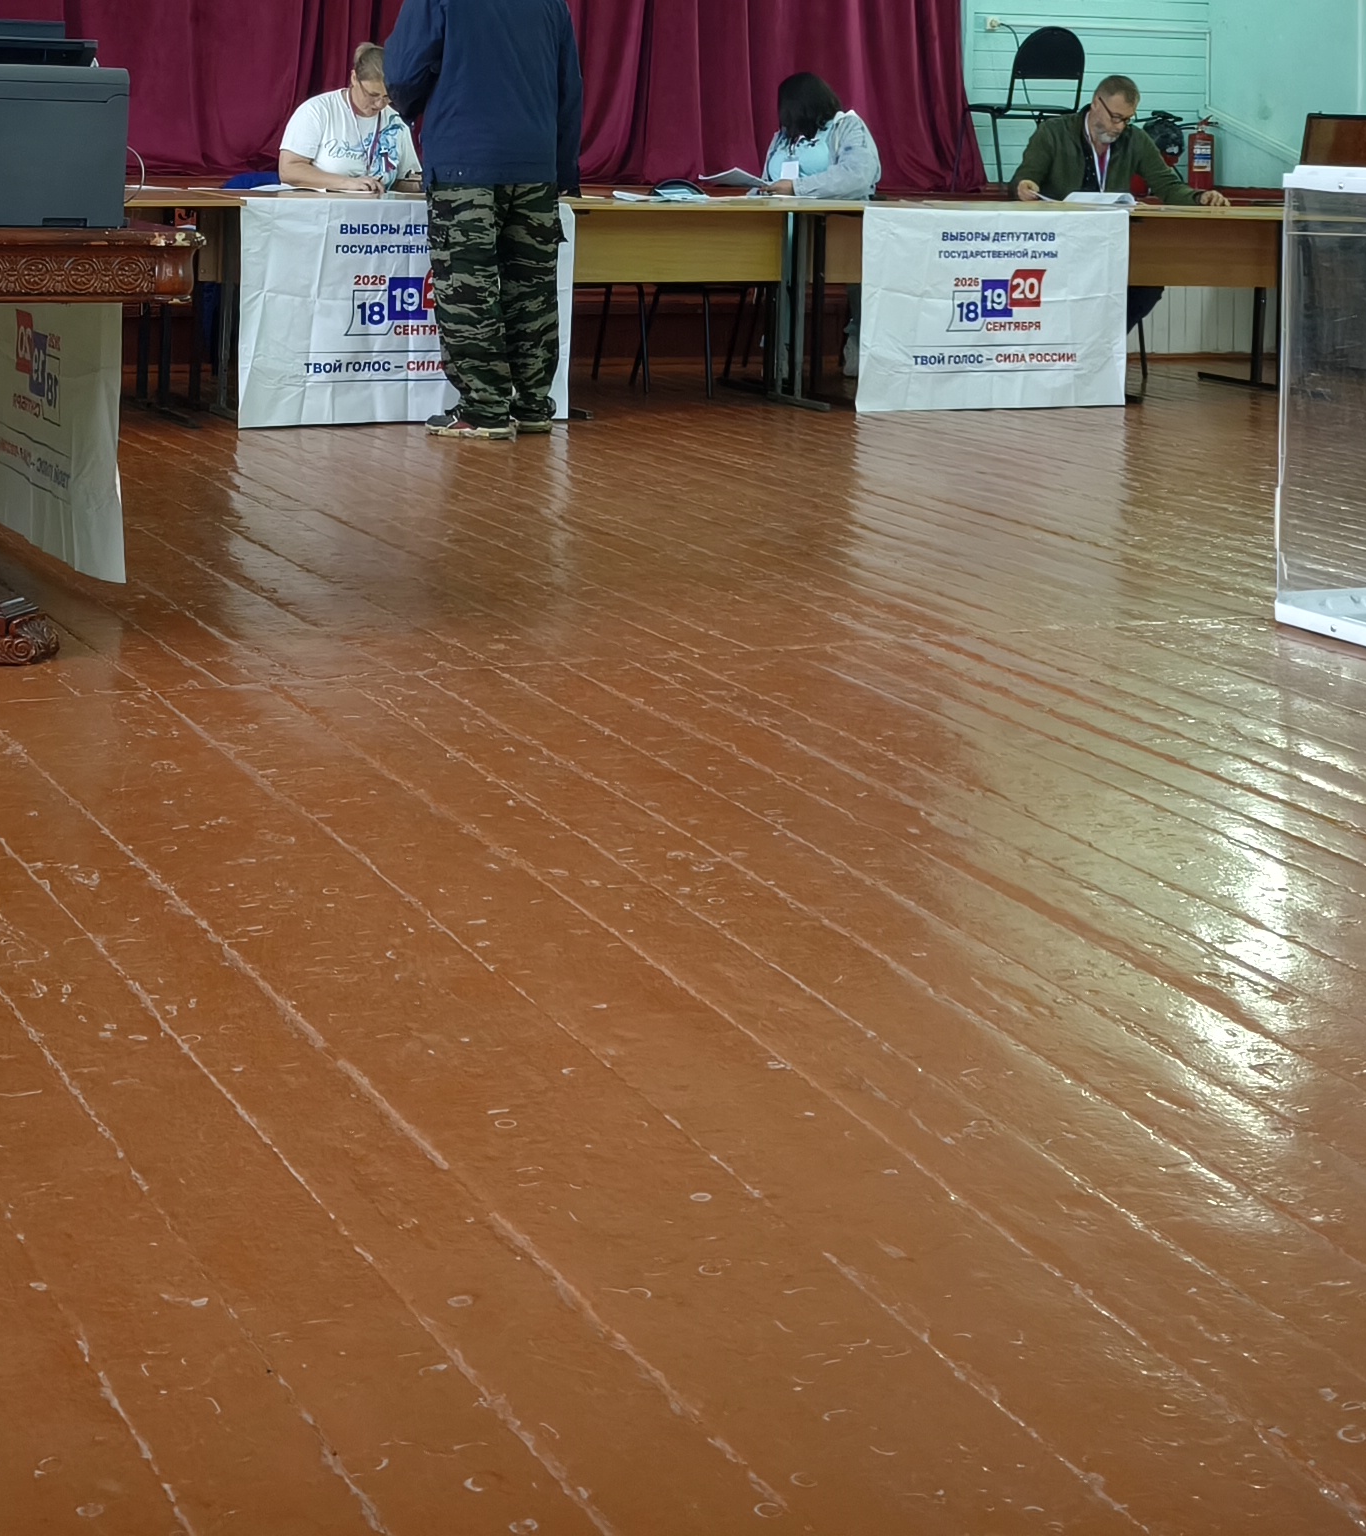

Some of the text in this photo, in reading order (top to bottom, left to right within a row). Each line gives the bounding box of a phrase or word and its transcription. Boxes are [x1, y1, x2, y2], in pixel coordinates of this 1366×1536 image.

[339, 223, 401, 235] ВЫБОРЫ
[941, 231, 1056, 243] ВЫБОРЫ ДЕПУТАТОВ
[335, 244, 432, 255] ГОСУДАРСТВЕНН
[938, 249, 1058, 259] ГОСУДАРСТВЕННОЙ ДУМЫ
[353, 274, 387, 286] 2026
[953, 277, 980, 288] 2026
[956, 277, 1040, 323] 18 19 20
[357, 301, 385, 326] 18
[392, 287, 421, 312] 19
[393, 324, 438, 336] СЕНТЯ
[985, 321, 1041, 332] СЕНТЯБРЯ
[913, 352, 946, 365] ТВОЙ
[947, 353, 984, 365] ГОЛОС
[995, 353, 1026, 364] СИЛА
[1029, 352, 1077, 363] РОССИИ!
[304, 359, 342, 374] ТВОЙ
[345, 360, 391, 373] ГОЛОС
[406, 360, 446, 372] СИЛА
